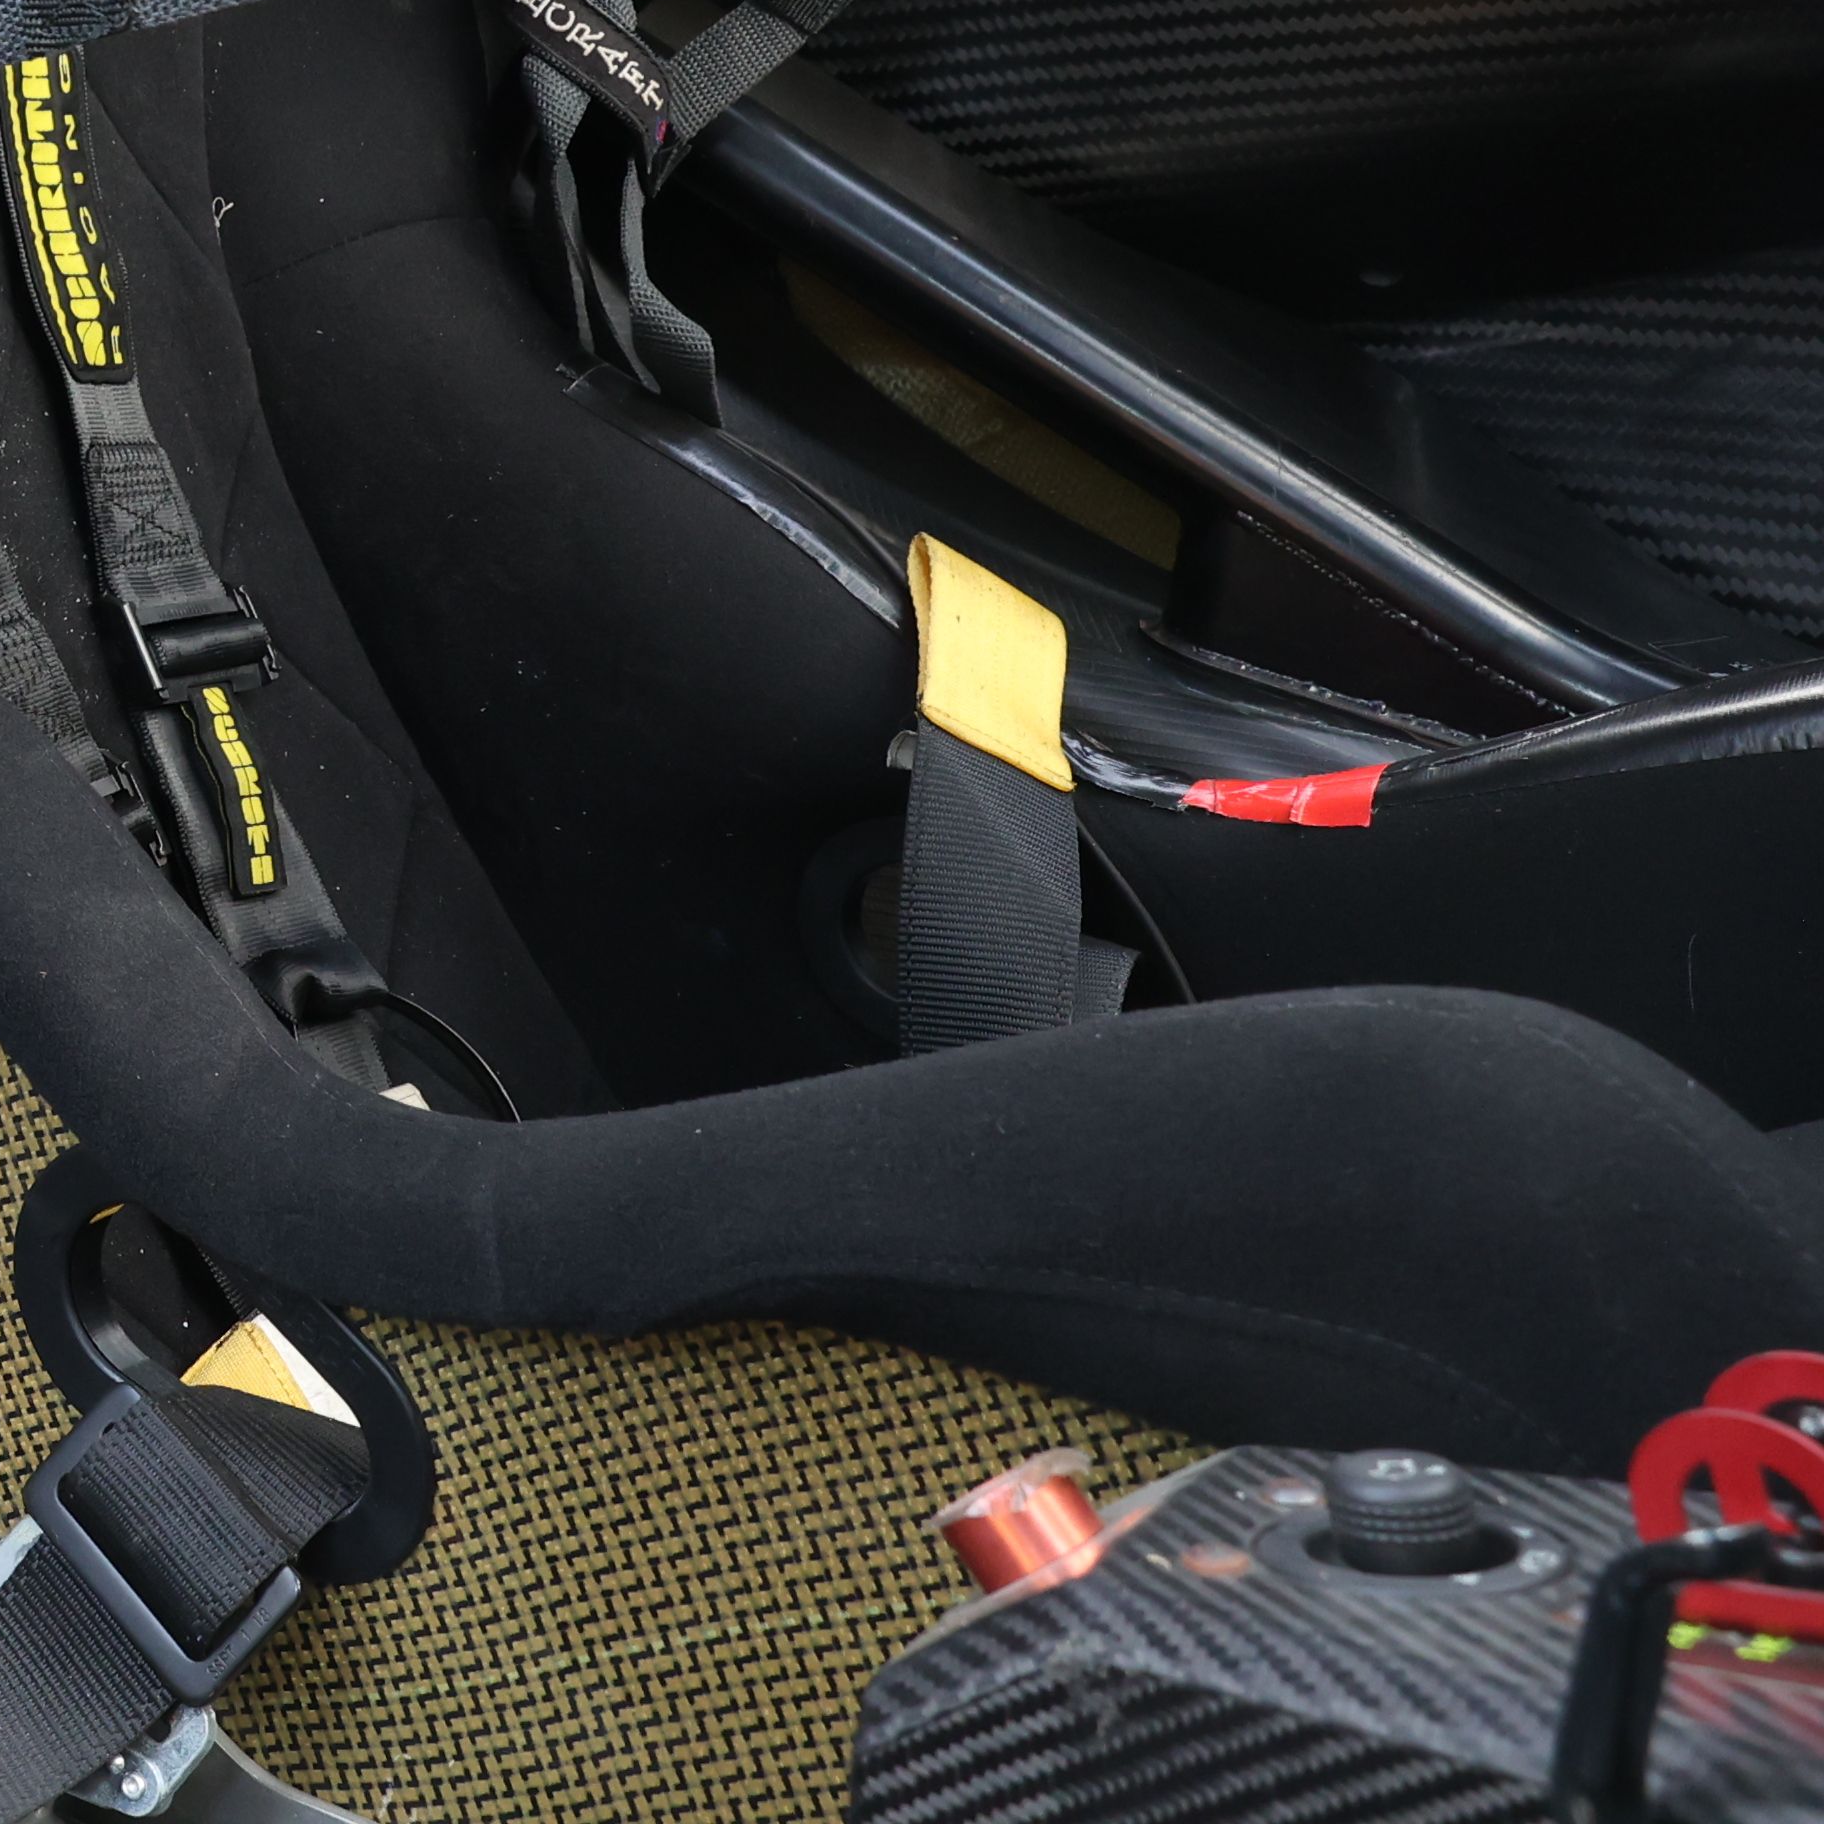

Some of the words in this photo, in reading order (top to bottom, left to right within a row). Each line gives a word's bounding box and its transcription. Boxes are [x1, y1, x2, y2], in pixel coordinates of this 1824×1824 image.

[24, 57, 109, 367] SCHROTH
[57, 52, 124, 366] RACING
[202, 686, 277, 887] SCHROTH
